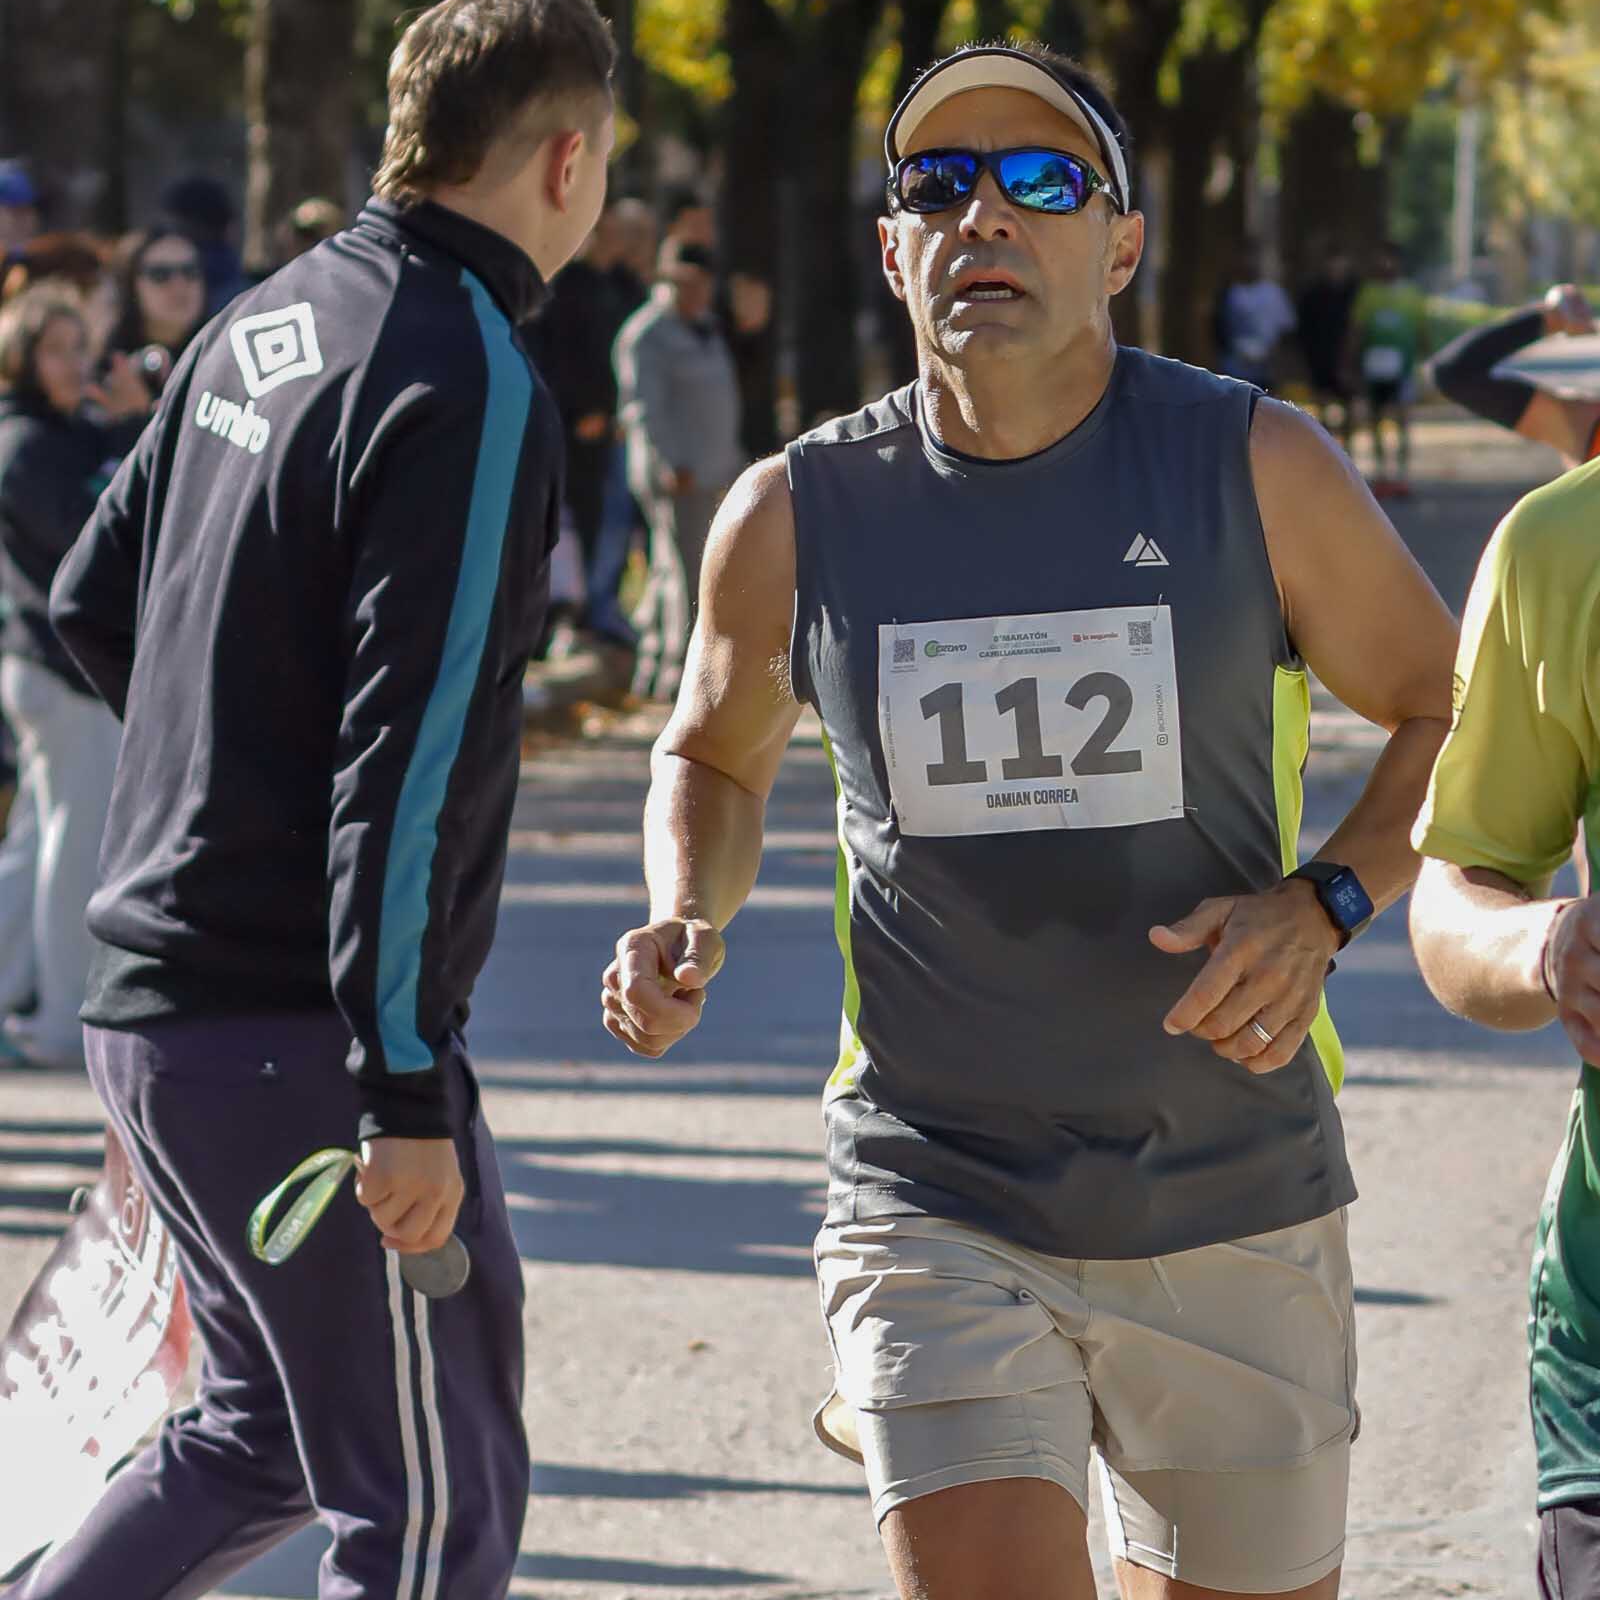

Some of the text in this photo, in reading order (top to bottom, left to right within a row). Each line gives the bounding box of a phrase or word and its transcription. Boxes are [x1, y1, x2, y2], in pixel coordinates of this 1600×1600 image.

[919, 671, 1143, 787] 112
[986, 788, 1079, 809] DAMIAN CORREA
